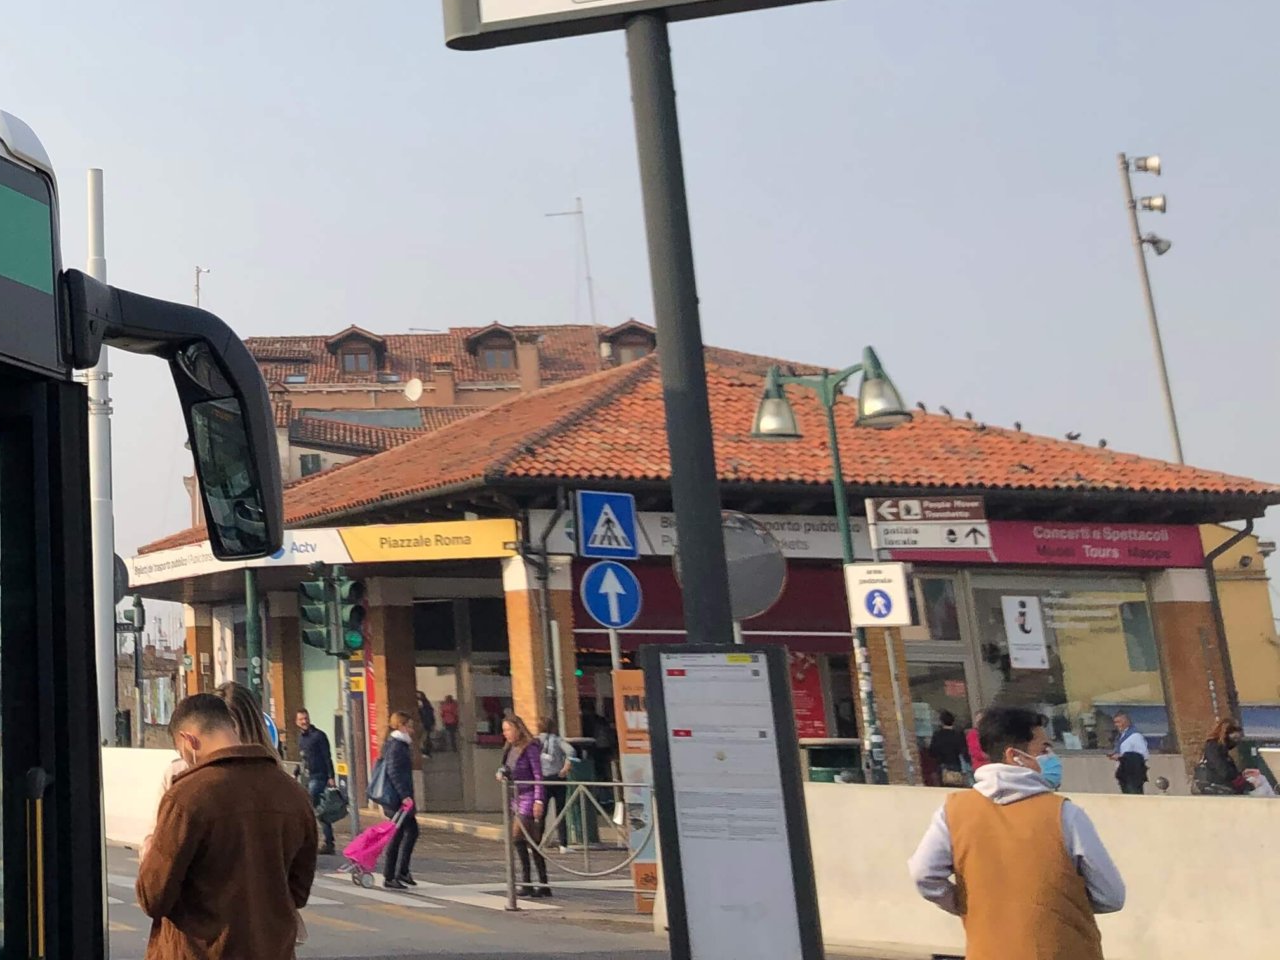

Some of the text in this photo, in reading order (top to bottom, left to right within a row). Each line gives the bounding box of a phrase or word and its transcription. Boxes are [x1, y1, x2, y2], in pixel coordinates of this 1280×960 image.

[1033, 526, 1090, 540] Concerti
[1102, 526, 1170, 542] Spettacoli
[290, 541, 317, 554] Actv
[380, 534, 472, 549] Piazzale Roma
[1082, 544, 1120, 558] Tours
